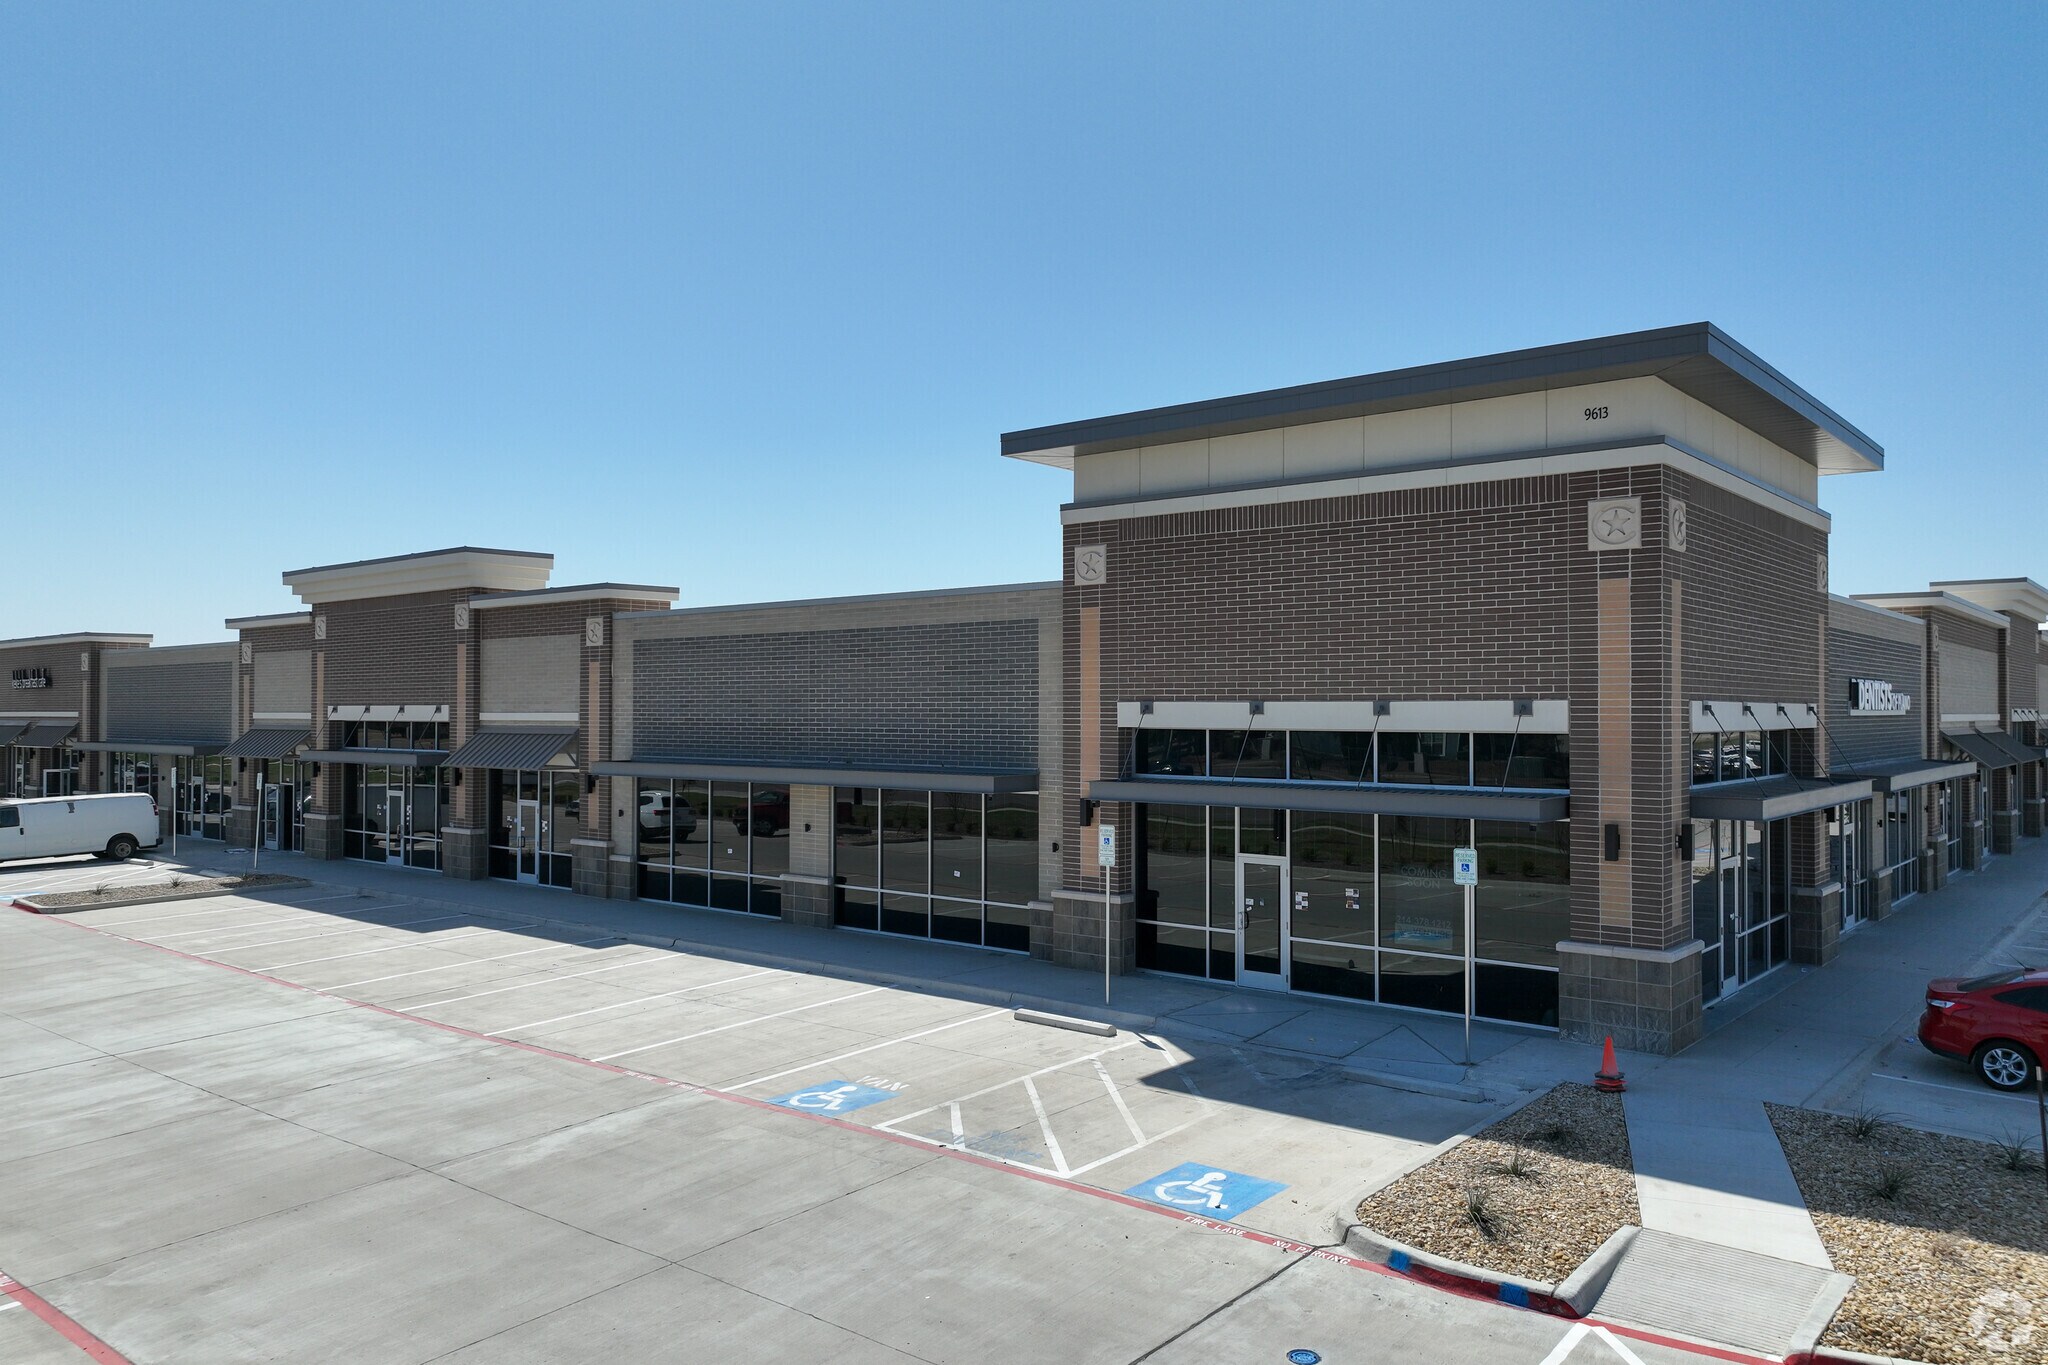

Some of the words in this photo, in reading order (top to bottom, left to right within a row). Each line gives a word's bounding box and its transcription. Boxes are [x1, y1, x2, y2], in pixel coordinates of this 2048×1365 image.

[1584, 406, 1609, 420] 9613
[1859, 682, 1892, 710] DENTISTS
[1401, 866, 1447, 879] COMING
[1407, 877, 1440, 888] SOON
[855, 1075, 911, 1092] VAN
[1184, 1216, 1211, 1228] FIRE
[1214, 1224, 1248, 1238] LANE
[1272, 1239, 1292, 1250] NO
[1296, 1244, 1352, 1266] PARKING
